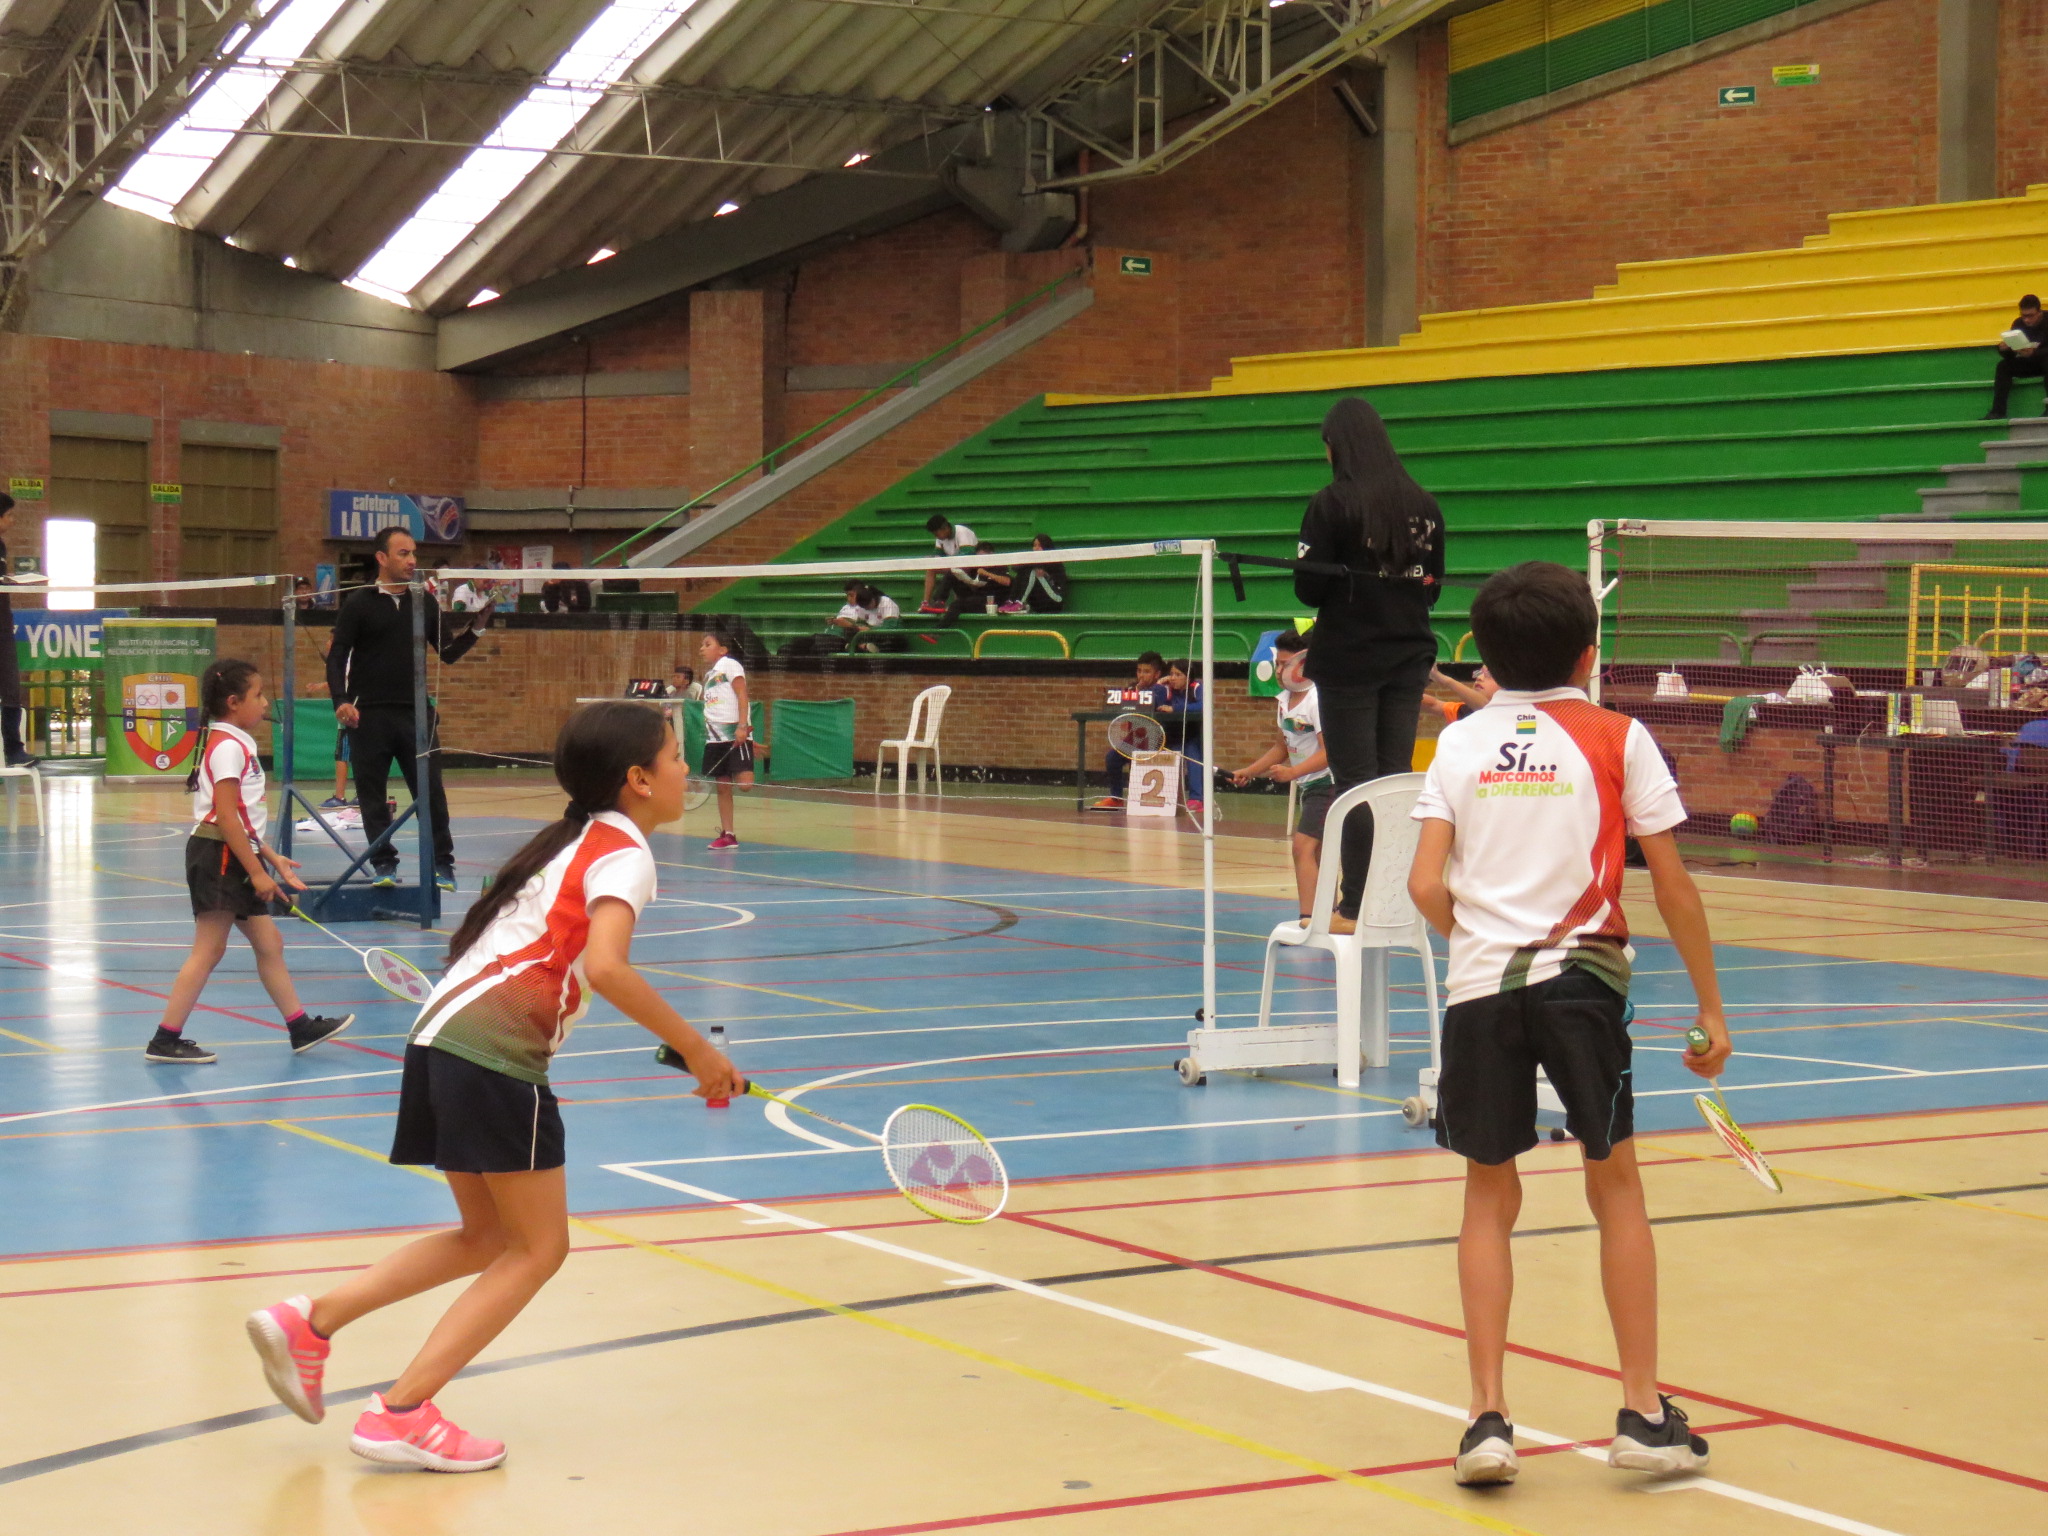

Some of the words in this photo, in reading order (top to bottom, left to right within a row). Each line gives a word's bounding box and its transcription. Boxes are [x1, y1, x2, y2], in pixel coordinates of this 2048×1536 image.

[12, 479, 42, 488] SALIDA
[152, 485, 180, 493] SALIDA
[341, 511, 362, 536] LA
[1107, 690, 1121, 704] 20
[1138, 690, 1153, 704] 15
[1479, 771, 1555, 784] Marcamos
[1140, 769, 1166, 807] 2
[1491, 782, 1574, 797] DIFERENCIA
